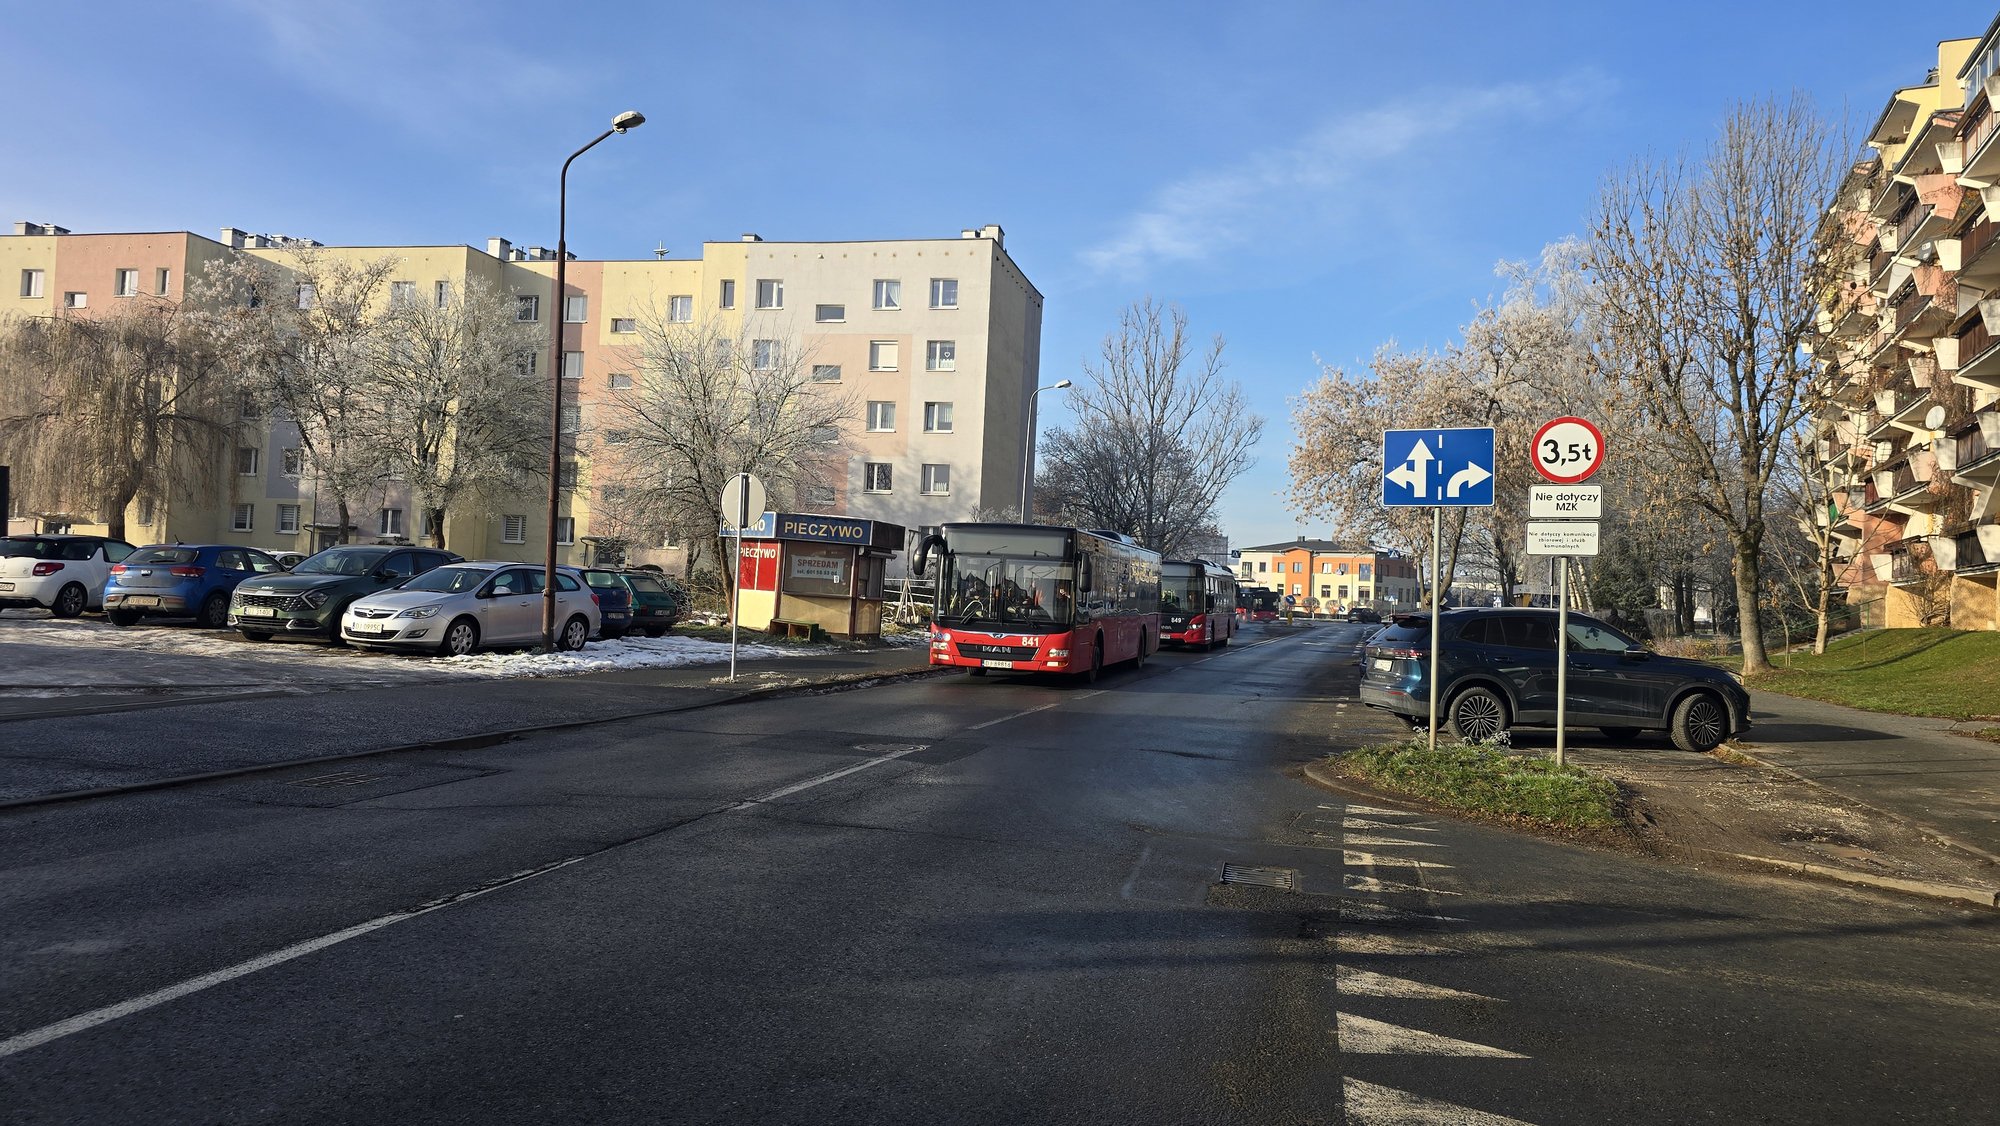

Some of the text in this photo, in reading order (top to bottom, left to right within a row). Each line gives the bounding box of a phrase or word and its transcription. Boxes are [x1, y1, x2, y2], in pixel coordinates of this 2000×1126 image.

[1542, 439, 1592, 466] 3,5t
[1535, 492, 1599, 503] Nie dotyczy
[1556, 503, 1578, 511] MZK
[784, 521, 863, 538] PIECZYWO
[797, 559, 839, 569] SPRZEDAM
[1021, 636, 1039, 647] 841
[982, 645, 1012, 654] MAN
